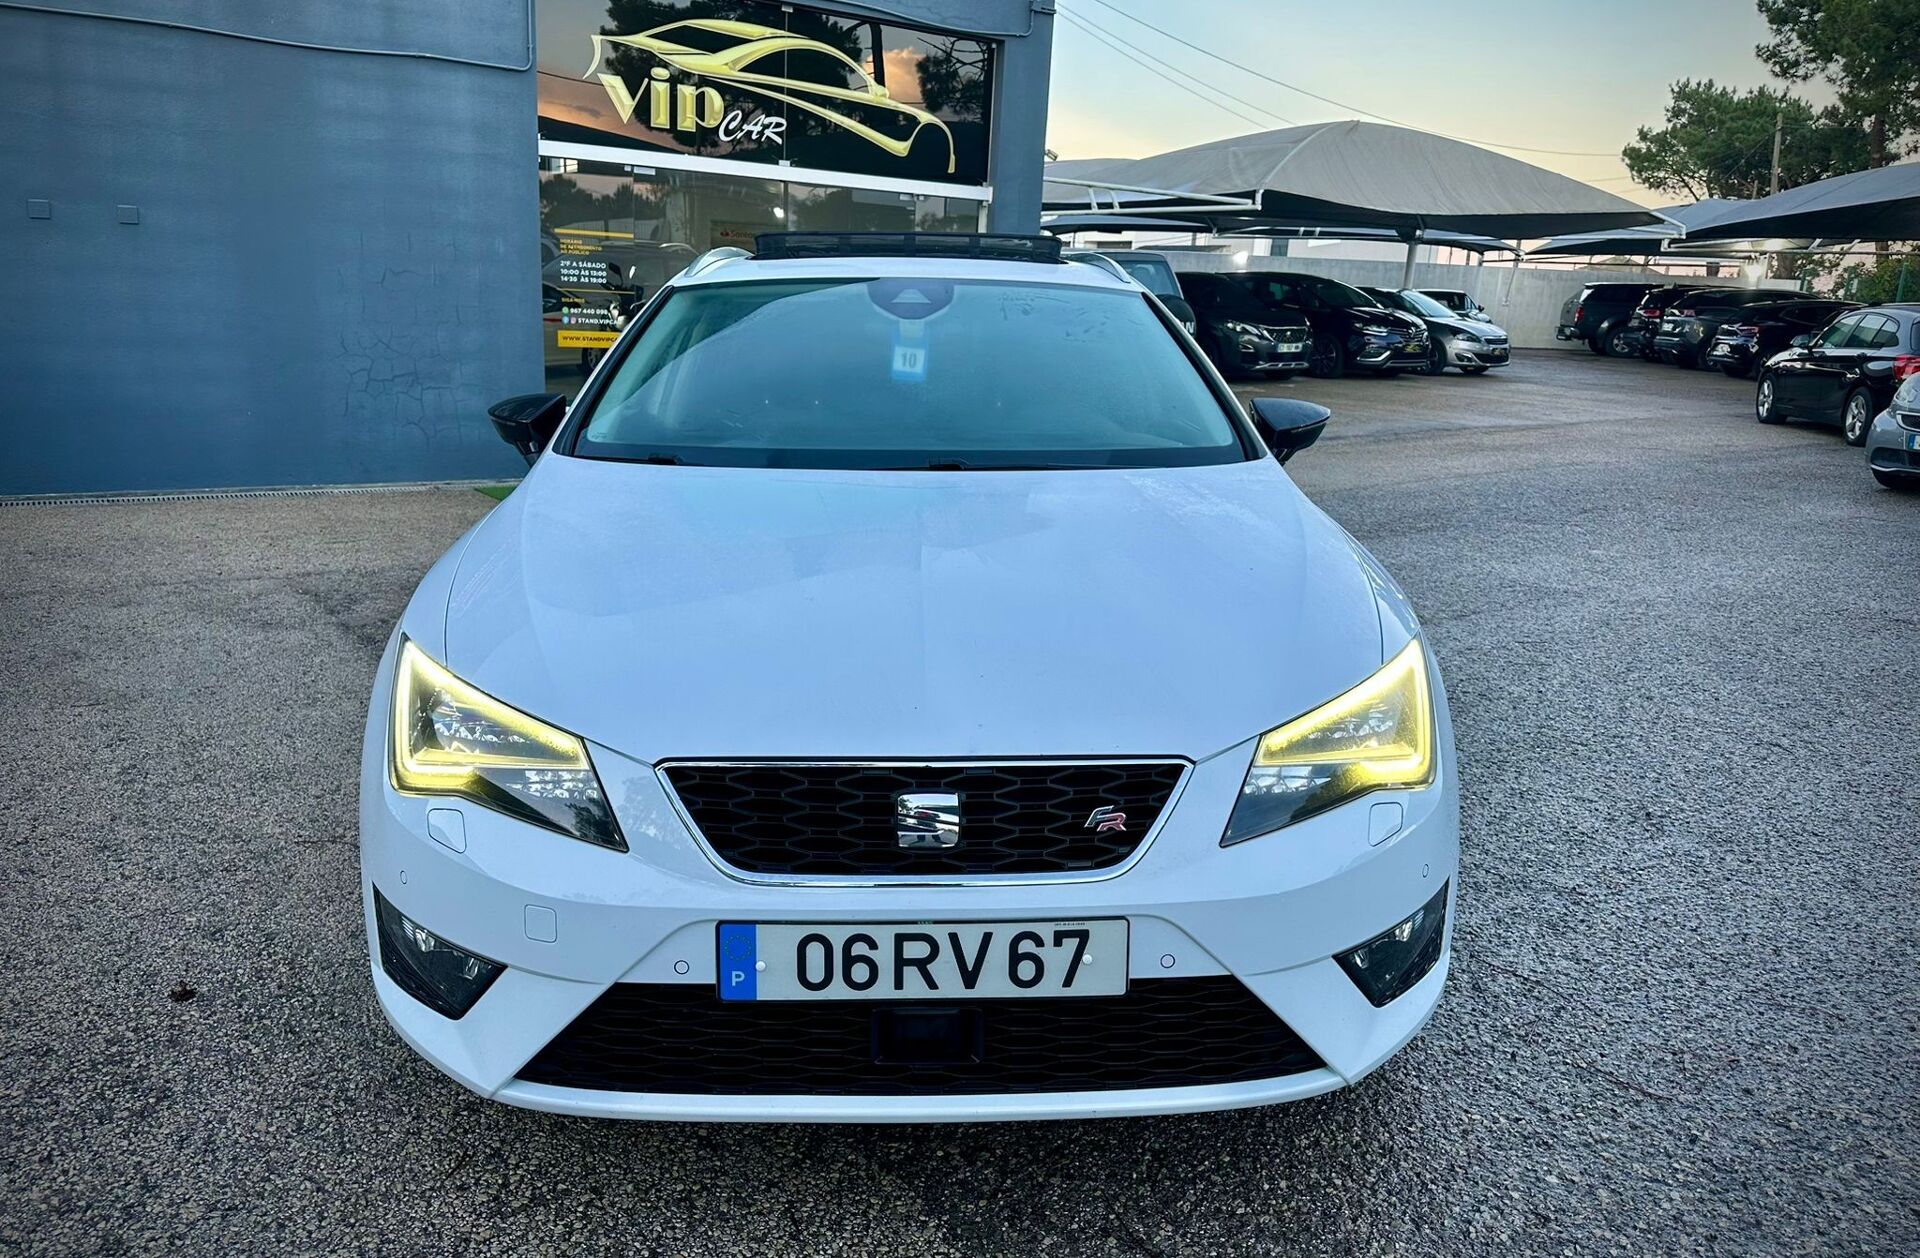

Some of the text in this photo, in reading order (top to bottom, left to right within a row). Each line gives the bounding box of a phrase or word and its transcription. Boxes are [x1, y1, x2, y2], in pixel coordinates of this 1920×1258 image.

[718, 110, 787, 145] CAR
[578, 260, 607, 269] SÁBADO
[580, 268, 589, 276] ÀS
[1084, 805, 1127, 832] FR
[731, 970, 745, 987] P
